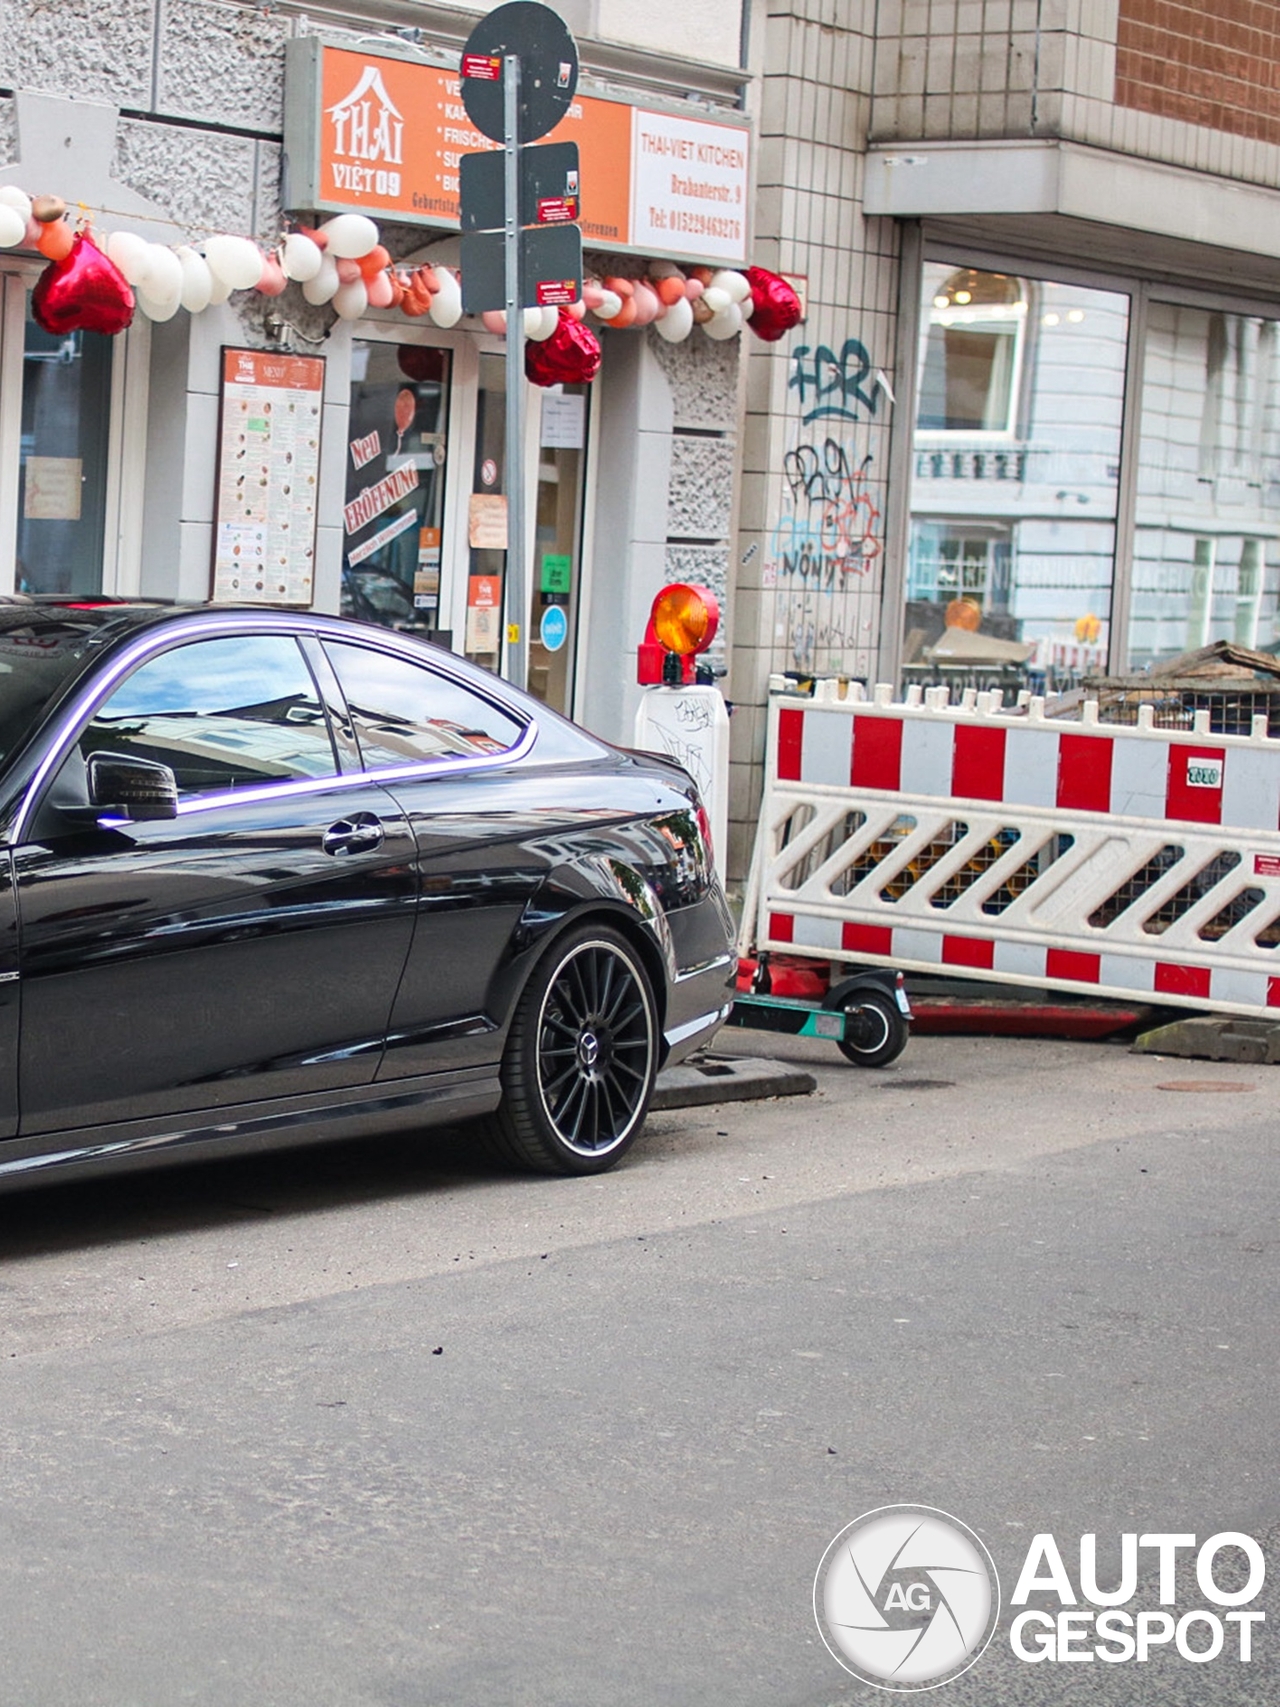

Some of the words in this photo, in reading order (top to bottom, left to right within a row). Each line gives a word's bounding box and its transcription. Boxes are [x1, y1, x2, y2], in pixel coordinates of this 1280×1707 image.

[331, 100, 404, 165] THAI
[443, 127, 495, 151] FRISCHE
[641, 132, 695, 160] THAI-VIET
[697, 143, 744, 169] KITCHEN
[735, 185, 742, 204] 9
[351, 432, 381, 468] Neu
[344, 464, 420, 533] ERÖFFNUNG
